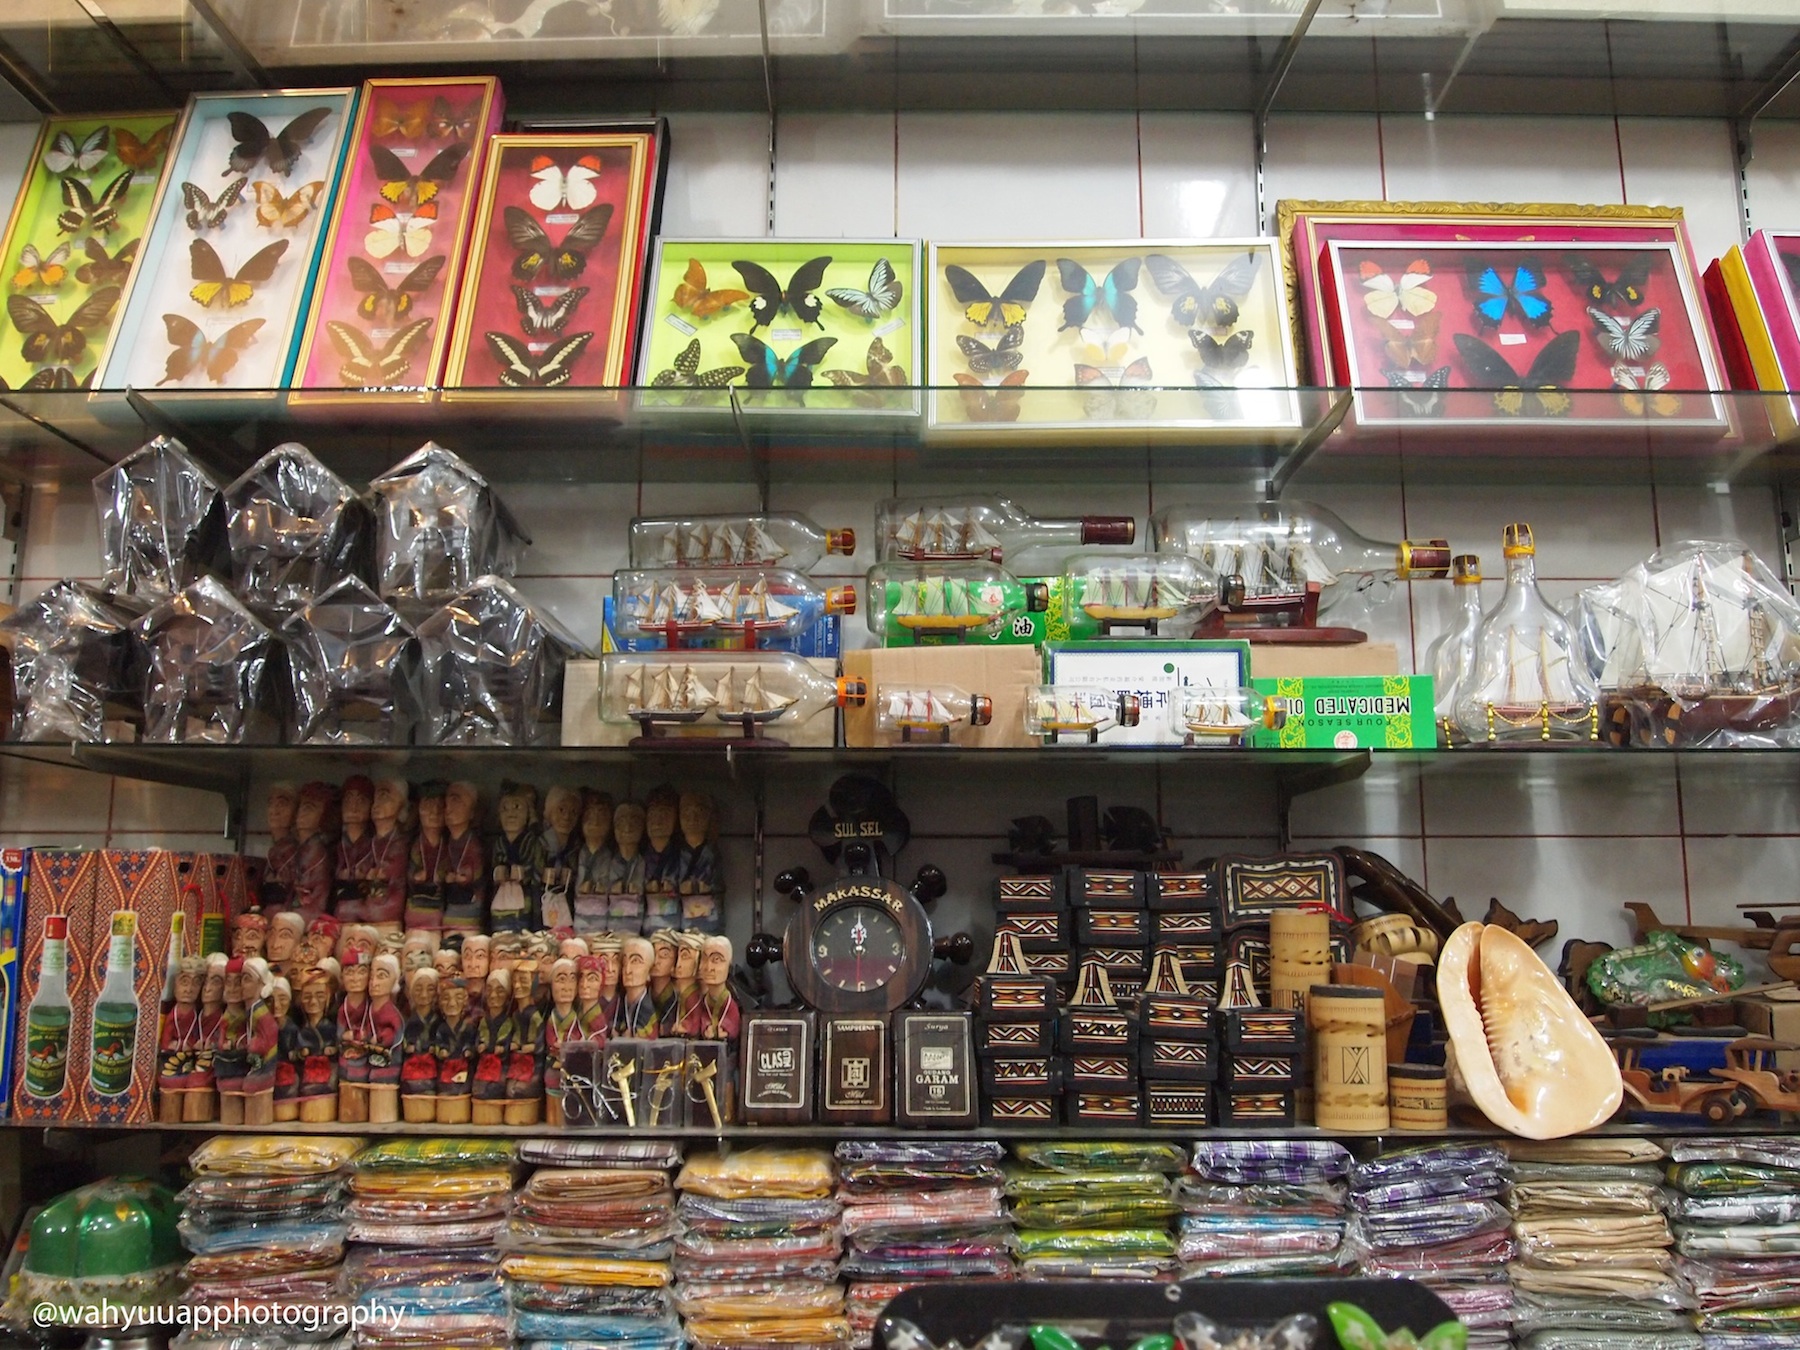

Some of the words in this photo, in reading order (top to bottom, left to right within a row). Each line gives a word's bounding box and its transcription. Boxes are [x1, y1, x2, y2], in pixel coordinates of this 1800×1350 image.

[1315, 697, 1410, 715] MEDICATED
[1298, 717, 1350, 726] SEASON
[1357, 717, 1391, 726] FOUR
[835, 823, 857, 838] SUL
[860, 822, 883, 837] SEL
[813, 885, 904, 912] MAKASSAR
[818, 944, 828, 957] 9
[891, 942, 900, 955] 3
[924, 1023, 949, 1032] Surya
[915, 1074, 959, 1085] GARAM
